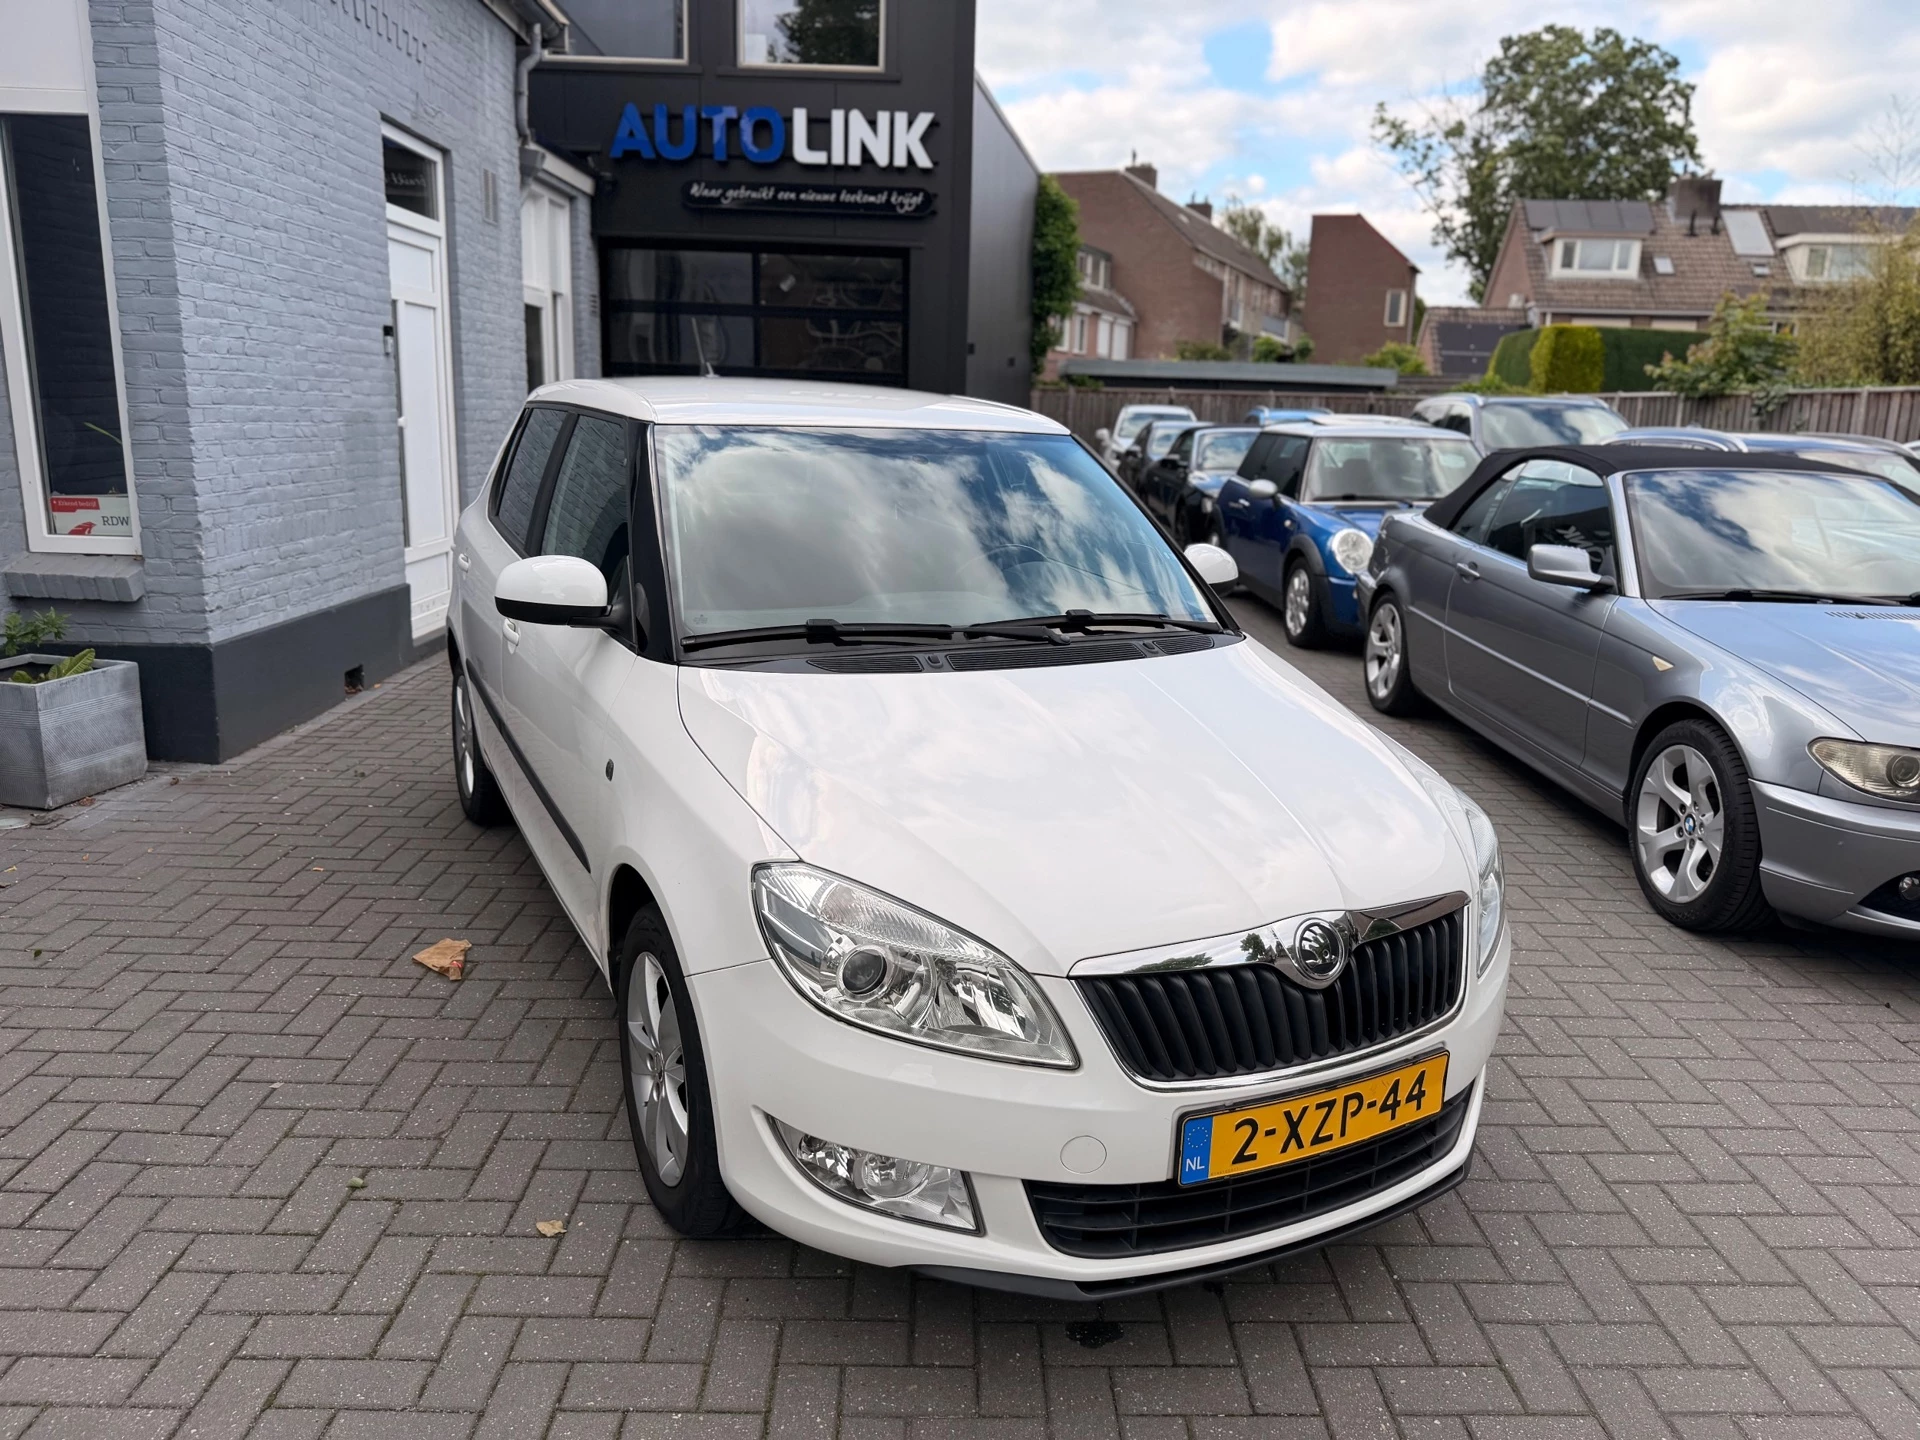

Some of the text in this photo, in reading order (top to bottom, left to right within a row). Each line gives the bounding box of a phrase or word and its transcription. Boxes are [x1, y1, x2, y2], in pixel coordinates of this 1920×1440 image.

[609, 102, 935, 169] AUTOLINK
[690, 182, 924, 214] Waar gebruikt een nieuwe toekomst krijgt
[101, 515, 130, 526] RDW
[1231, 1069, 1427, 1166] 2-XZP-44
[1185, 1156, 1206, 1172] NL
